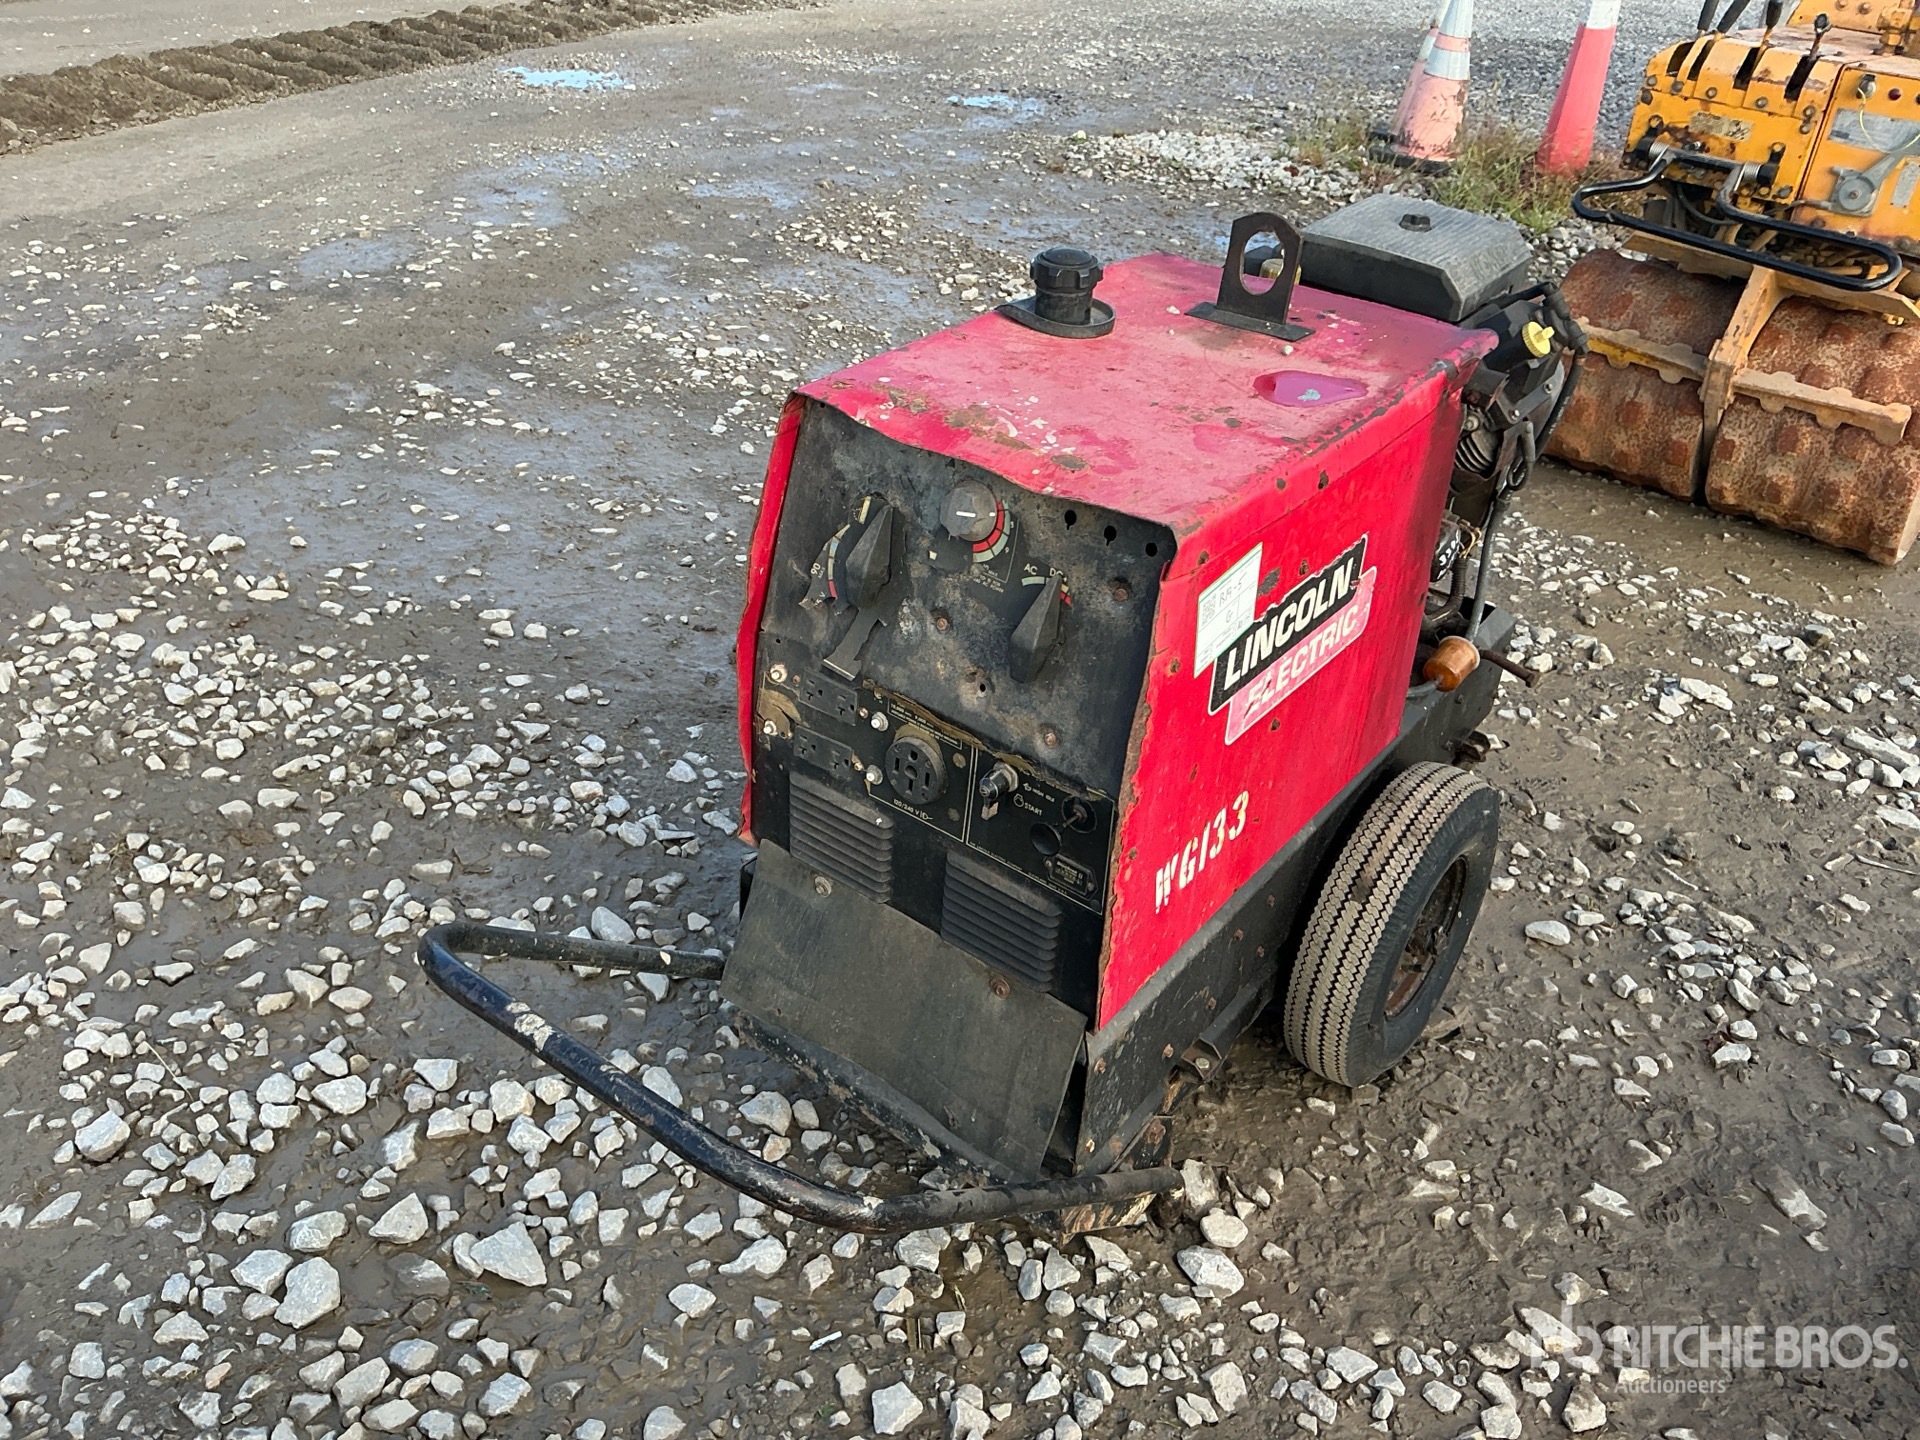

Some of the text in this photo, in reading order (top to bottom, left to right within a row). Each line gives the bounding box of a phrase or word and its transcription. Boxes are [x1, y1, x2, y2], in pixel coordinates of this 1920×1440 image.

[810, 562, 821, 575] 90
[1023, 563, 1038, 575] AC
[1224, 557, 1355, 691] LINCOLN
[1245, 604, 1360, 715] ELECTRIC
[1024, 802, 1043, 816] START
